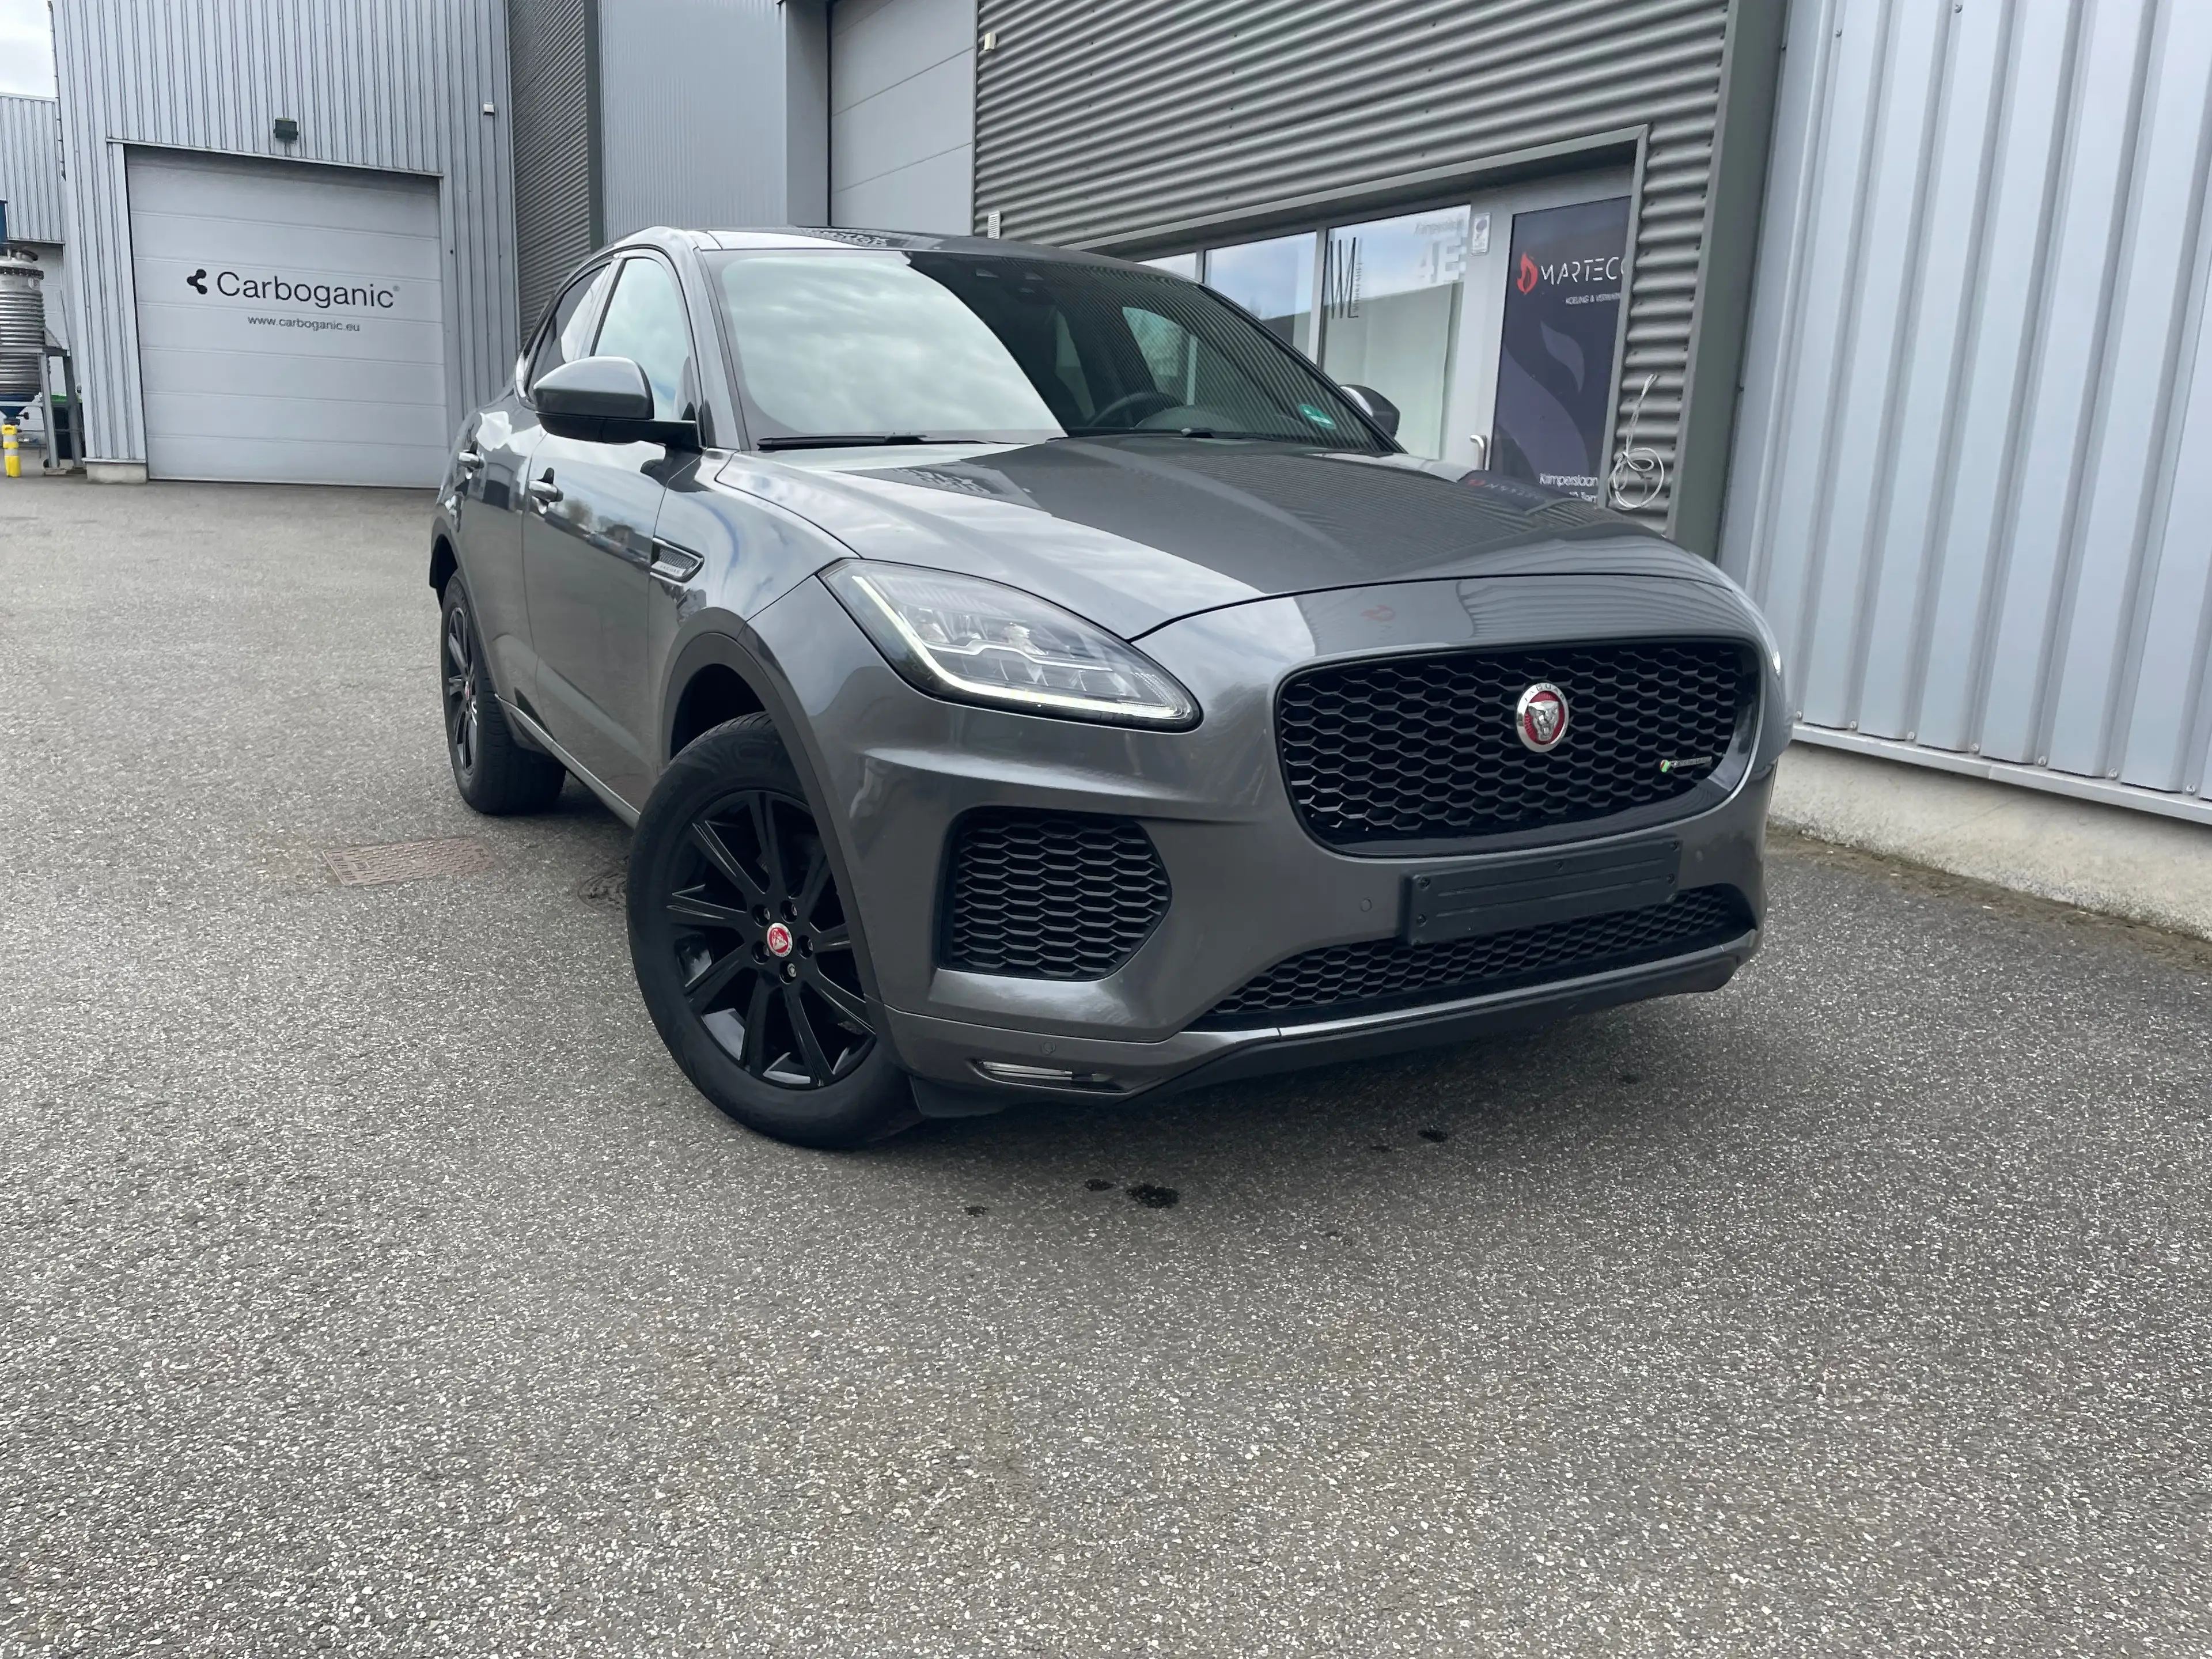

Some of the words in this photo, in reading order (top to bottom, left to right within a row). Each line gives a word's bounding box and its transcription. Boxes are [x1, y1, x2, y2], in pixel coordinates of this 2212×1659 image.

[1540, 256, 1624, 285] MARTEC
[217, 271, 394, 309] Carboganic
[247, 315, 361, 332] www.carboganic.eu
